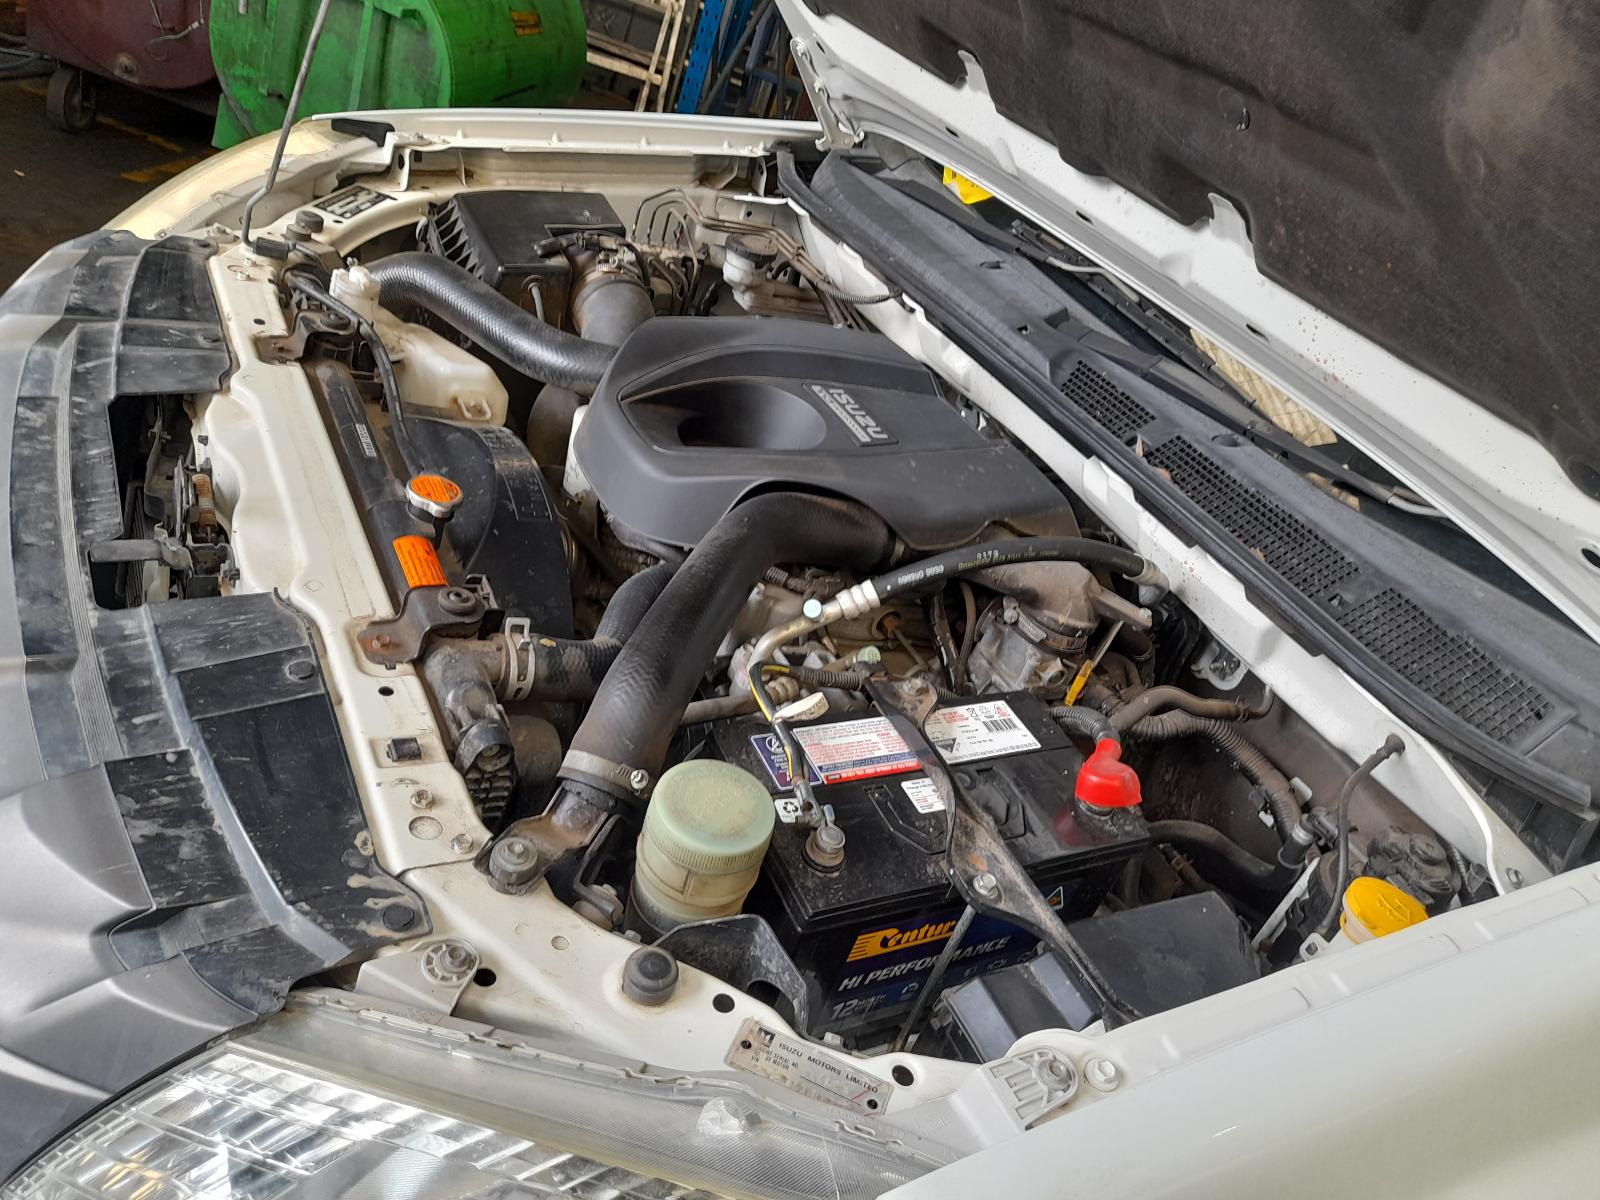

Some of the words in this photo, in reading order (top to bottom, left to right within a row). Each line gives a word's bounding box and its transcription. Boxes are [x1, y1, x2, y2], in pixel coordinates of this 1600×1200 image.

[829, 388, 889, 439] ISUZU
[847, 920, 958, 962] Centur
[838, 975, 864, 992] HI
[831, 999, 859, 1020] 12
[778, 1042, 803, 1058] ISUZU
[807, 1056, 842, 1076] MOTORS
[845, 1073, 878, 1094] LIMITED
